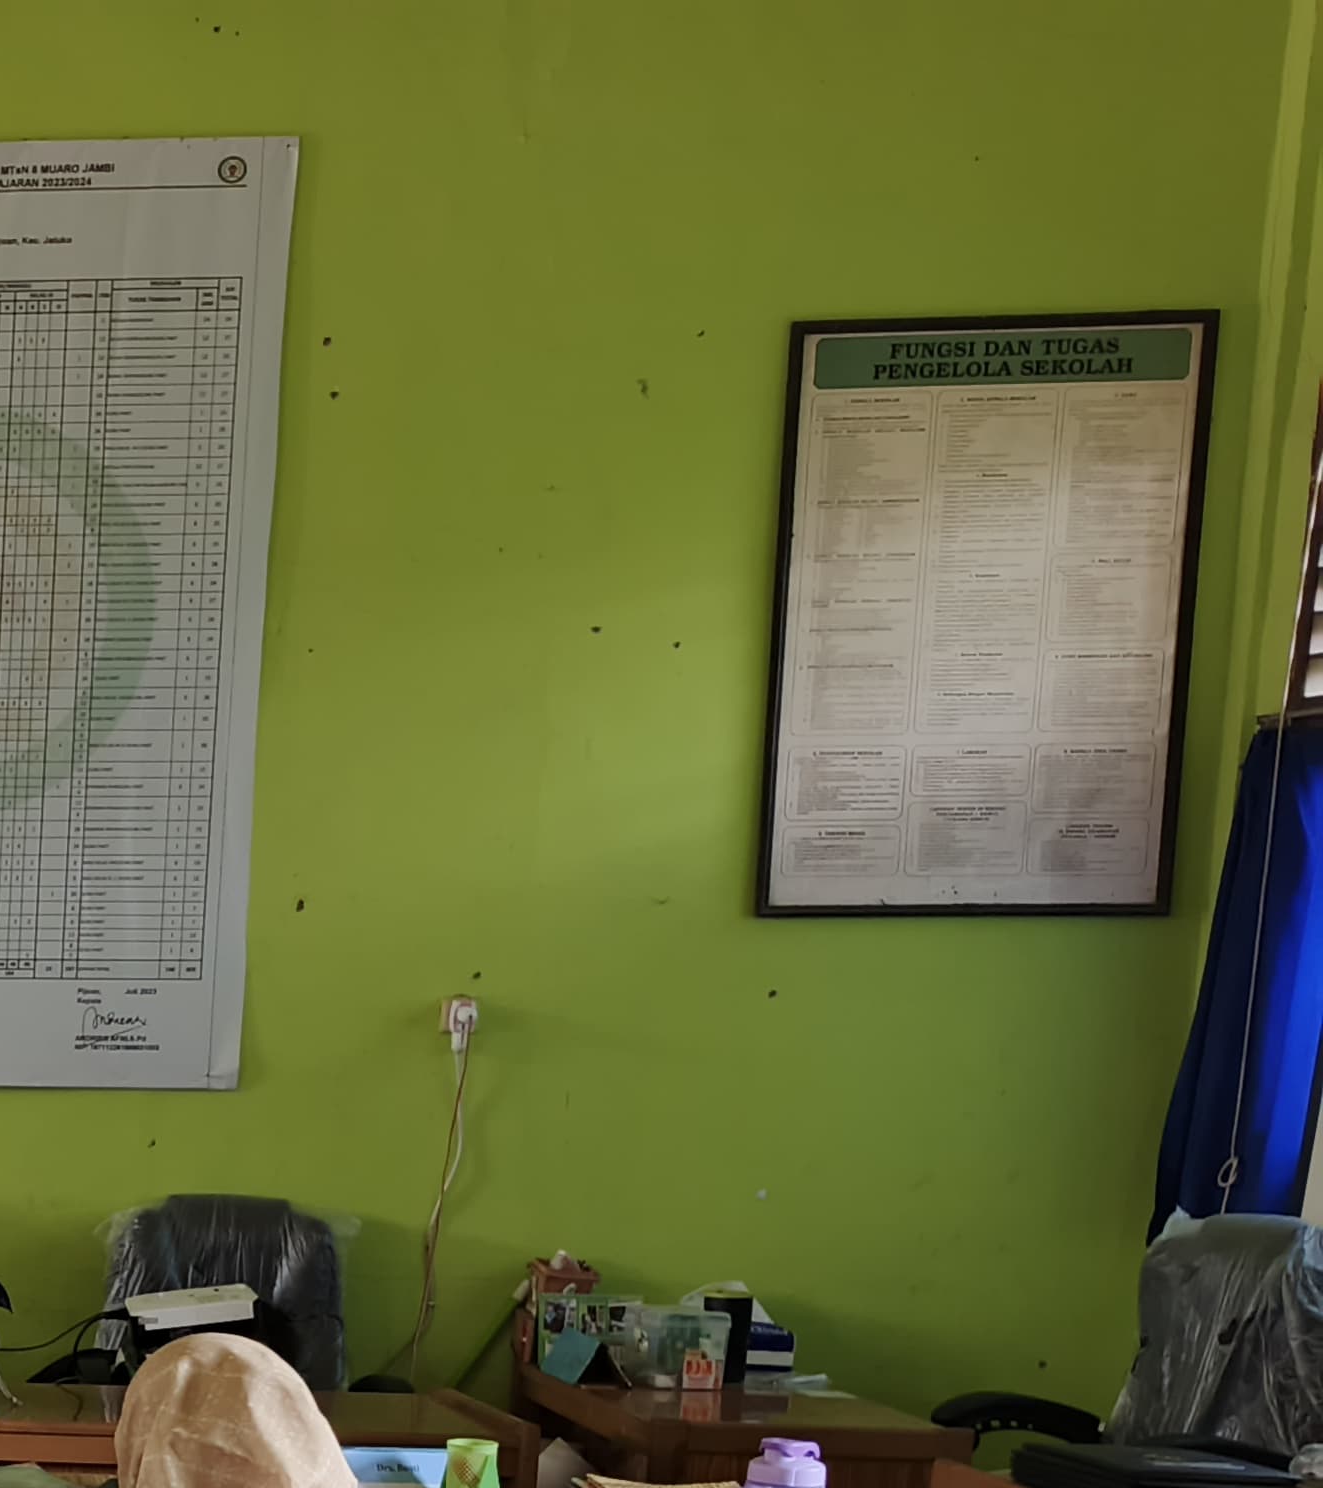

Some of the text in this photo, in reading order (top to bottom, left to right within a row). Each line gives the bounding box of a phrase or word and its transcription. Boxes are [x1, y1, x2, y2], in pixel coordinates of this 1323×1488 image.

[41, 163, 79, 175] MUARO
[82, 161, 115, 173] JAMBI
[42, 176, 93, 188] 2023/2024
[889, 336, 1121, 361] FUNGSI DAN TUGAS
[872, 357, 1135, 381] PENGELOLA SEKOLAH
